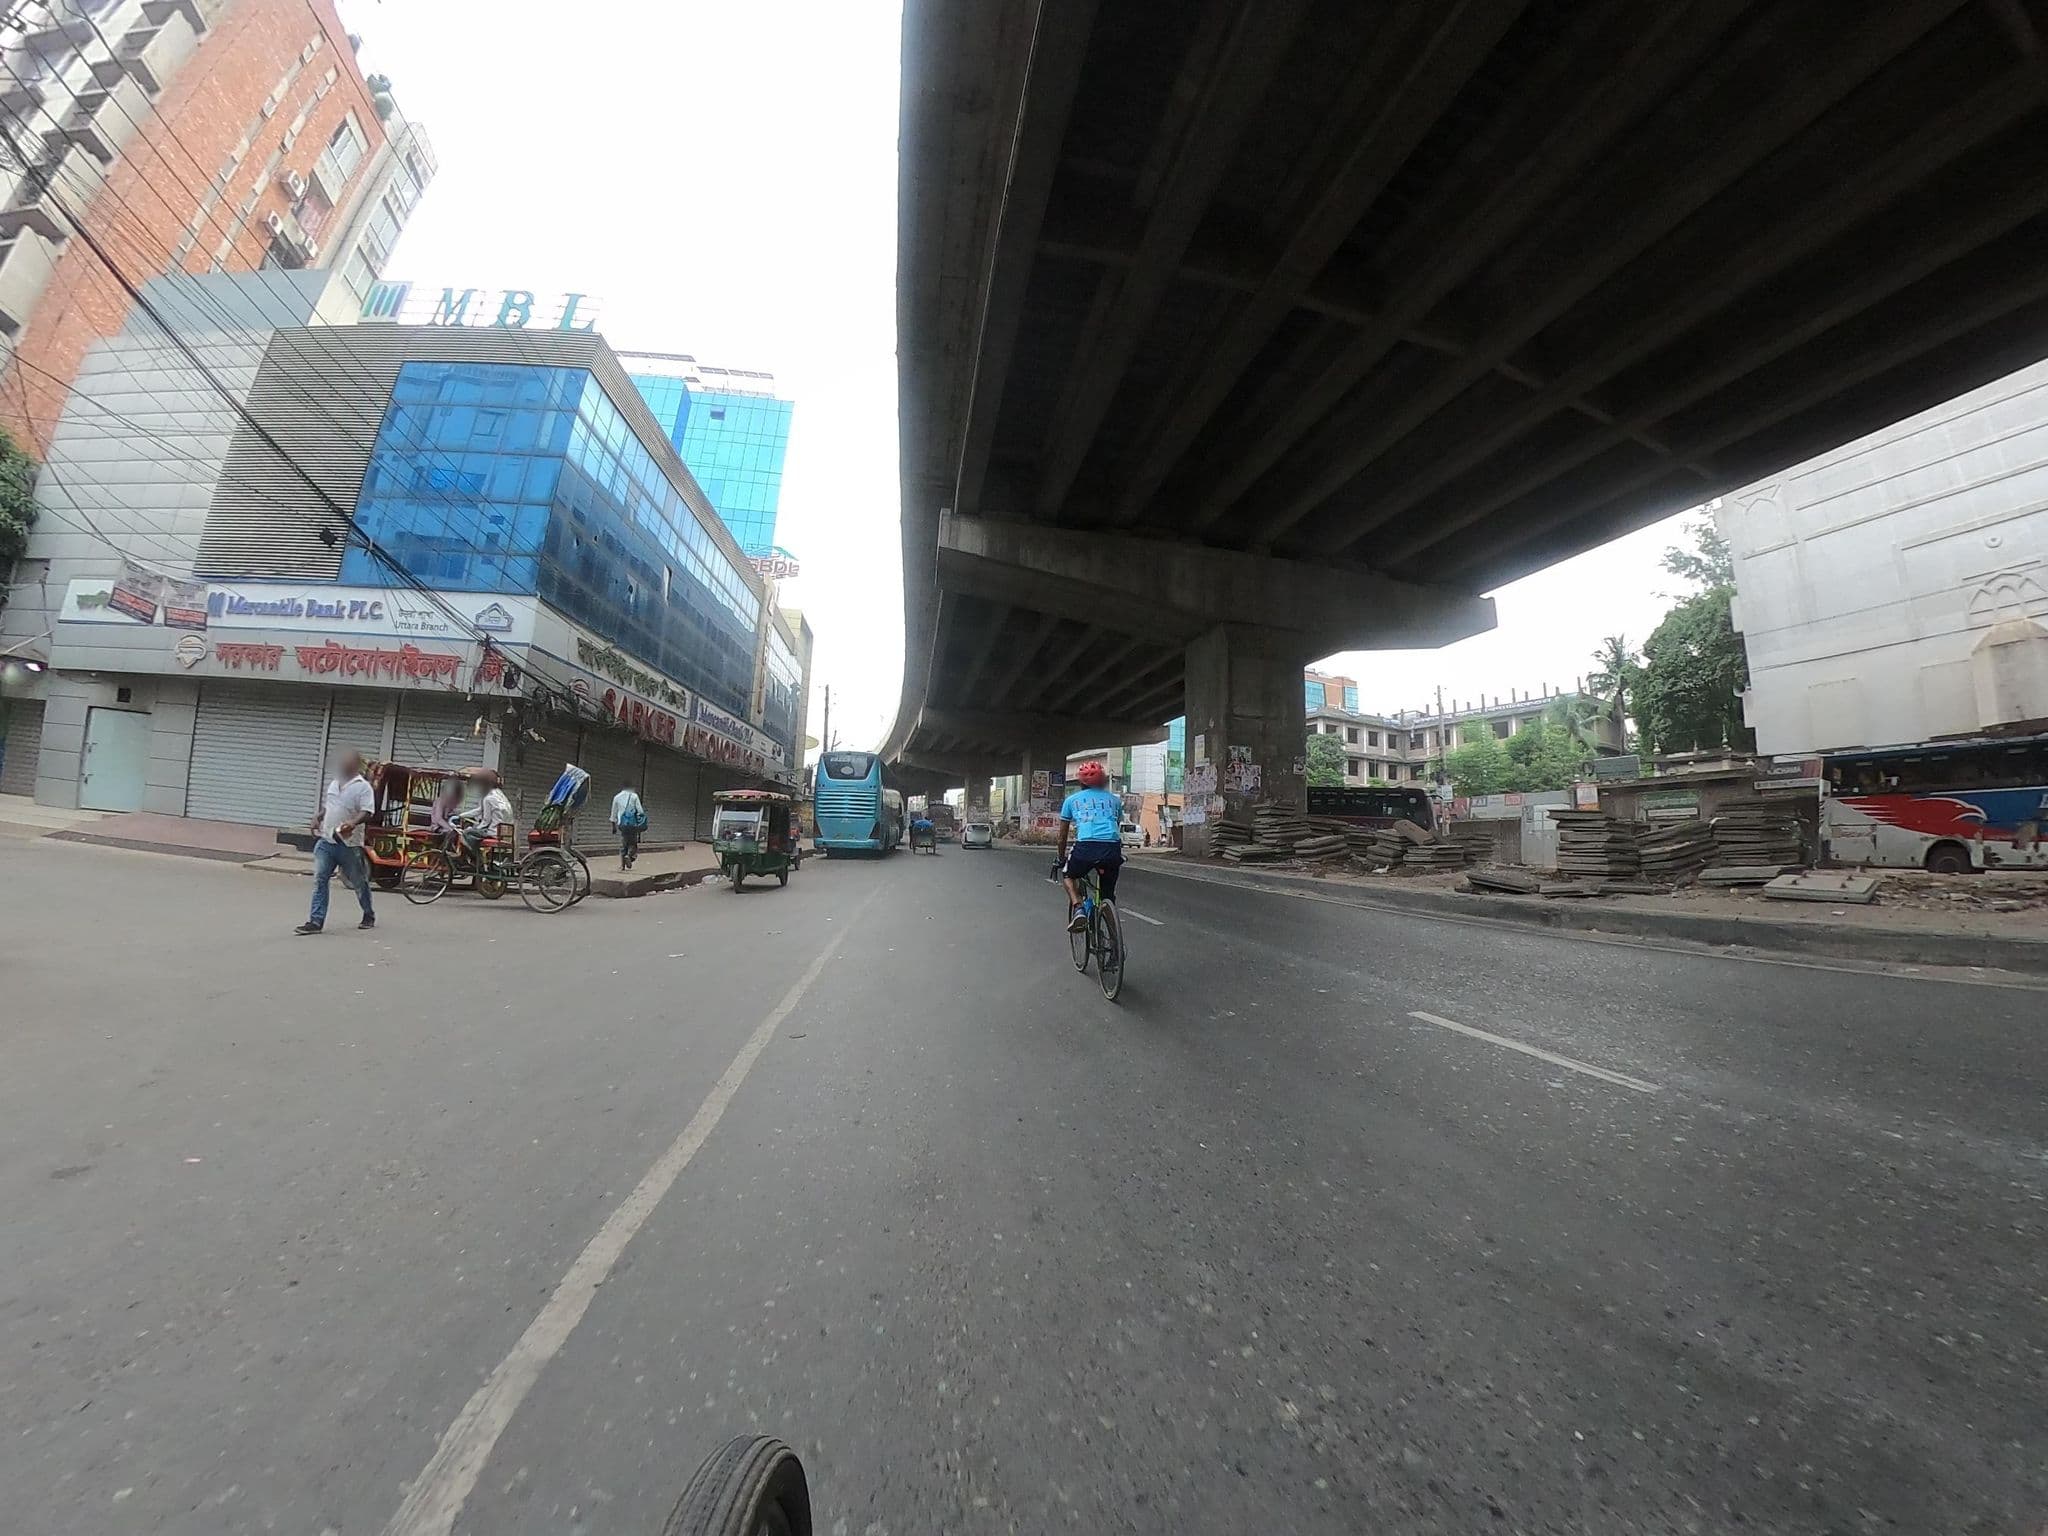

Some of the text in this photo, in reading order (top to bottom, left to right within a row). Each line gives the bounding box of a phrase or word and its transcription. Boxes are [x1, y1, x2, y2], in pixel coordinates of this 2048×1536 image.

[426, 288, 595, 333] MBL
[226, 595, 384, 620] Mercantile Bank PLC
[395, 620, 449, 632] Uttara Branch
[215, 641, 285, 671] সরকার
[600, 688, 676, 745] SARKER
